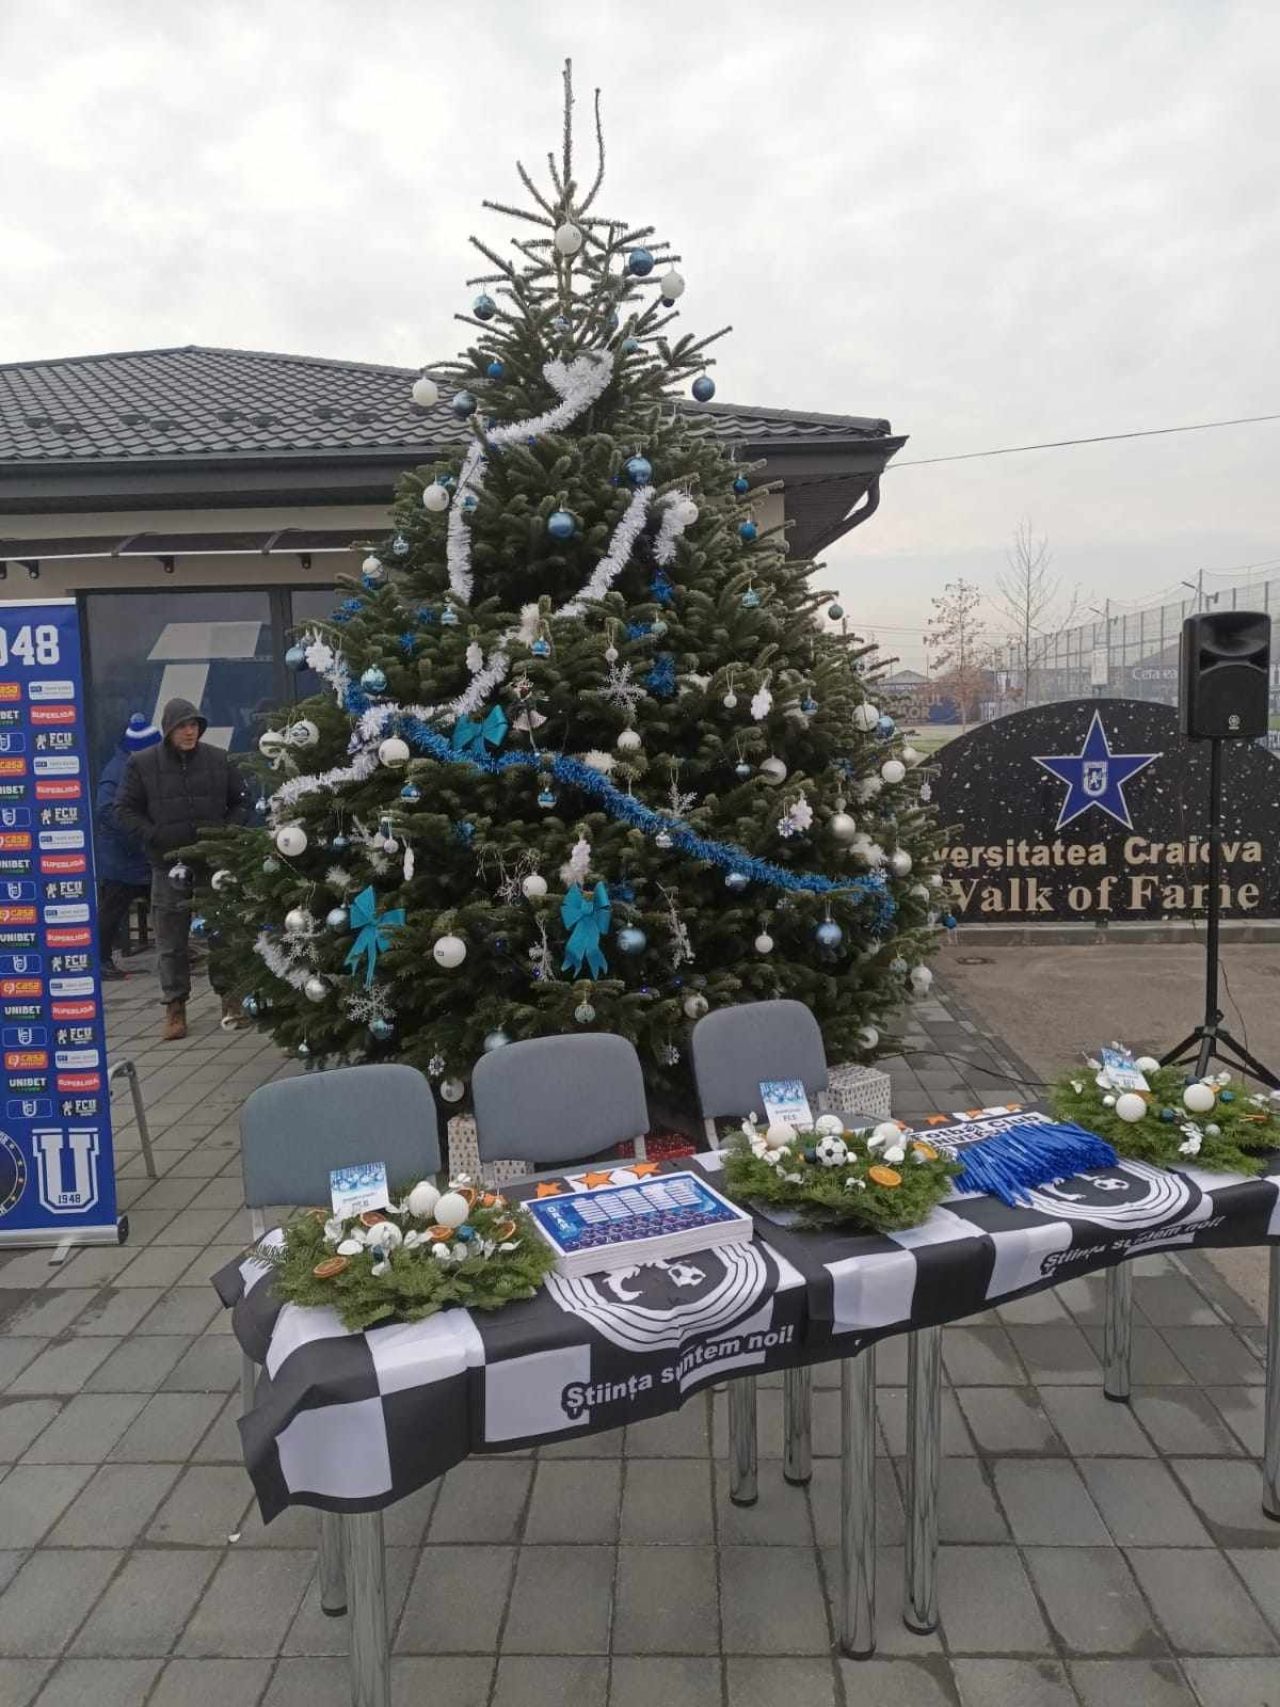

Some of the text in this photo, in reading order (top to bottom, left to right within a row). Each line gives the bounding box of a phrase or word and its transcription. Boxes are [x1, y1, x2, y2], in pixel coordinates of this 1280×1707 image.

[1068, 876, 1118, 912] of
[4, 1005, 41, 1015] UNIBET
[9, 1077, 47, 1087] UNIBET
[58, 1193, 81, 1205] 1948
[748, 1323, 795, 1351] noi!
